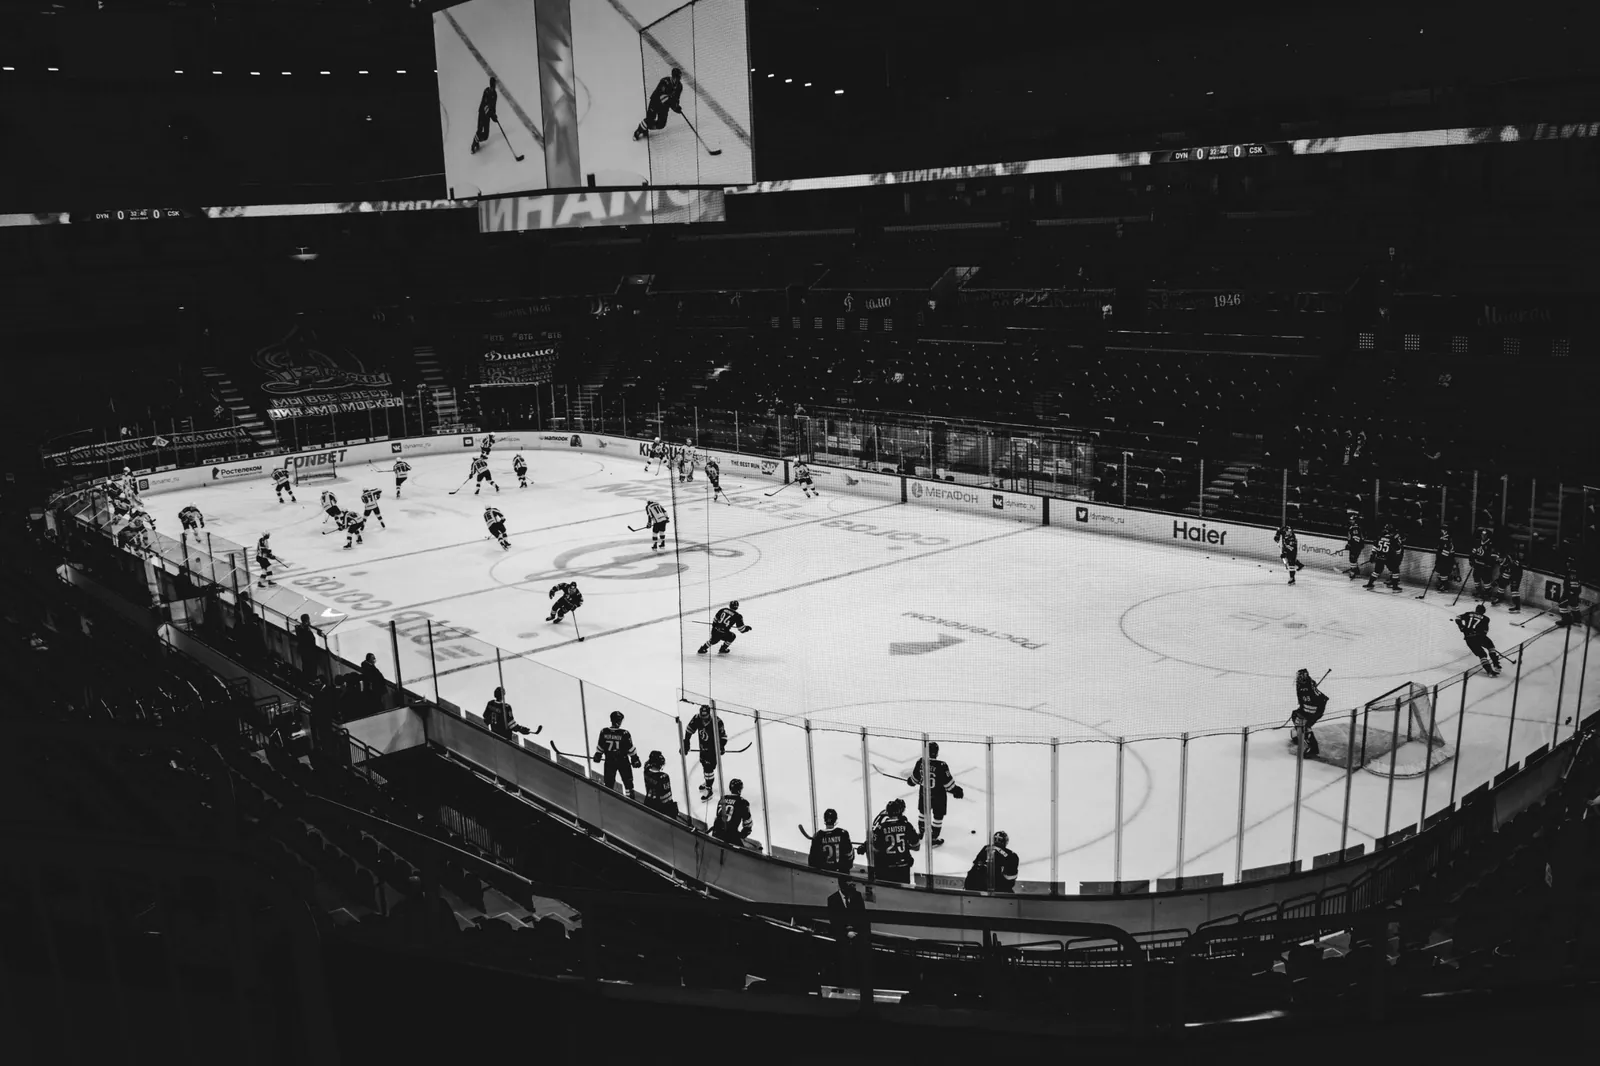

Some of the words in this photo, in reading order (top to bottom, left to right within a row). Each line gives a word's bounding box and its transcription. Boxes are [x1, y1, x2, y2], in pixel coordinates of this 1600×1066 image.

[1196, 148, 1203, 160] 0
[1233, 145, 1241, 157] 0
[1249, 146, 1262, 154] CSK
[117, 210, 124, 220] 0
[153, 209, 160, 219] 0
[1213, 294, 1241, 308] 1946
[484, 348, 554, 361] Динамо
[284, 449, 347, 469] FONBET
[221, 465, 262, 475] Ростелеком
[925, 486, 979, 503] МЕГАФОН
[1173, 520, 1227, 545] Haier
[1378, 541, 1390, 552] 55
[718, 612, 731, 627] 94
[1467, 617, 1481, 629] 17
[606, 741, 620, 751] 71
[885, 833, 906, 854] 25
[822, 844, 840, 864] 21
